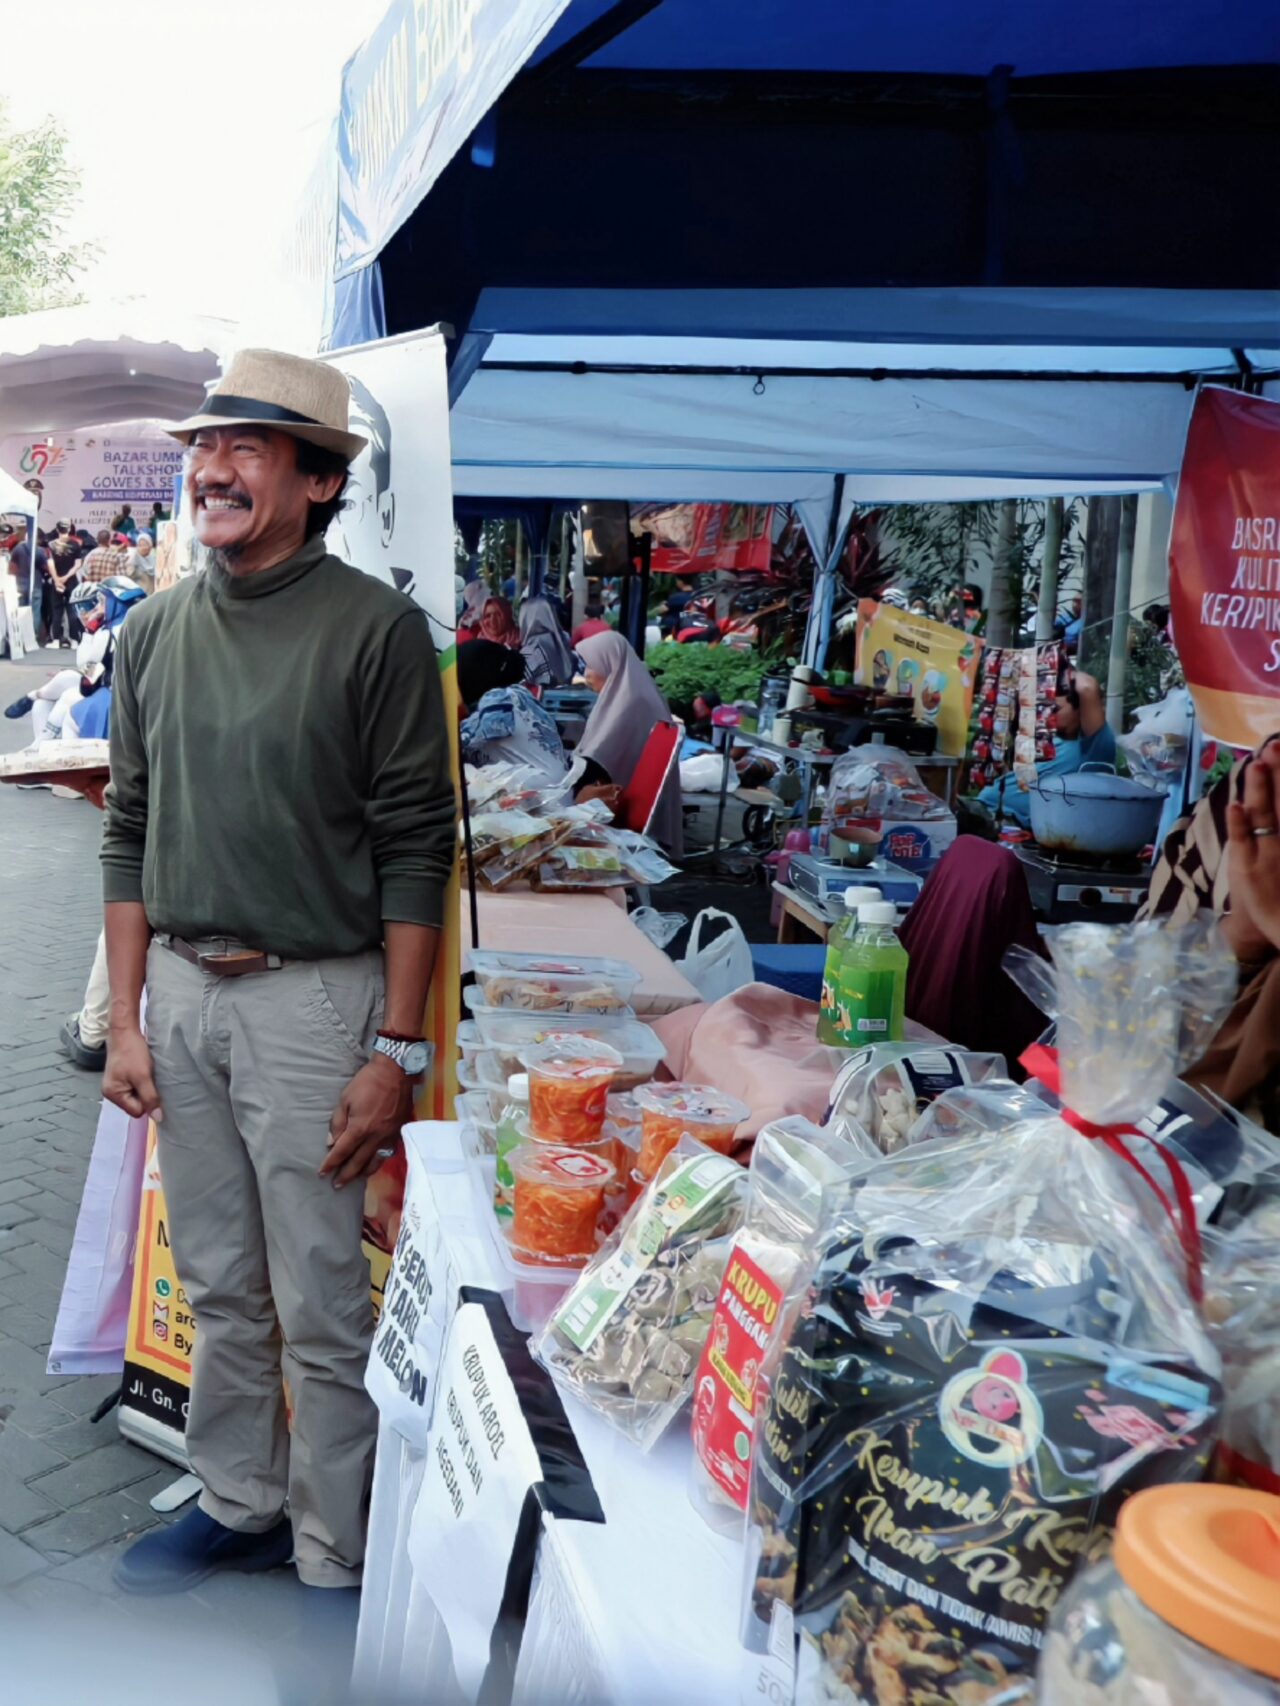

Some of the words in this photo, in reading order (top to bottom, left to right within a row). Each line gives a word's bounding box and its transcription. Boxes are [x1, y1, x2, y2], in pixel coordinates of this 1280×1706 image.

[103, 452, 149, 462] BAZAR
[152, 452, 184, 462] UMK
[92, 476, 141, 488] GOWES
[145, 476, 155, 488] &
[159, 476, 174, 488] SE
[1231, 517, 1280, 550] BASR
[727, 1260, 778, 1325] KRUPU
[721, 1288, 769, 1351] PANGGAN
[377, 1326, 428, 1407] MELON
[129, 1379, 148, 1398] Jl.
[152, 1386, 177, 1412] Gn.
[856, 1495, 942, 1564] Ikan
[950, 1546, 1064, 1612] Pati
